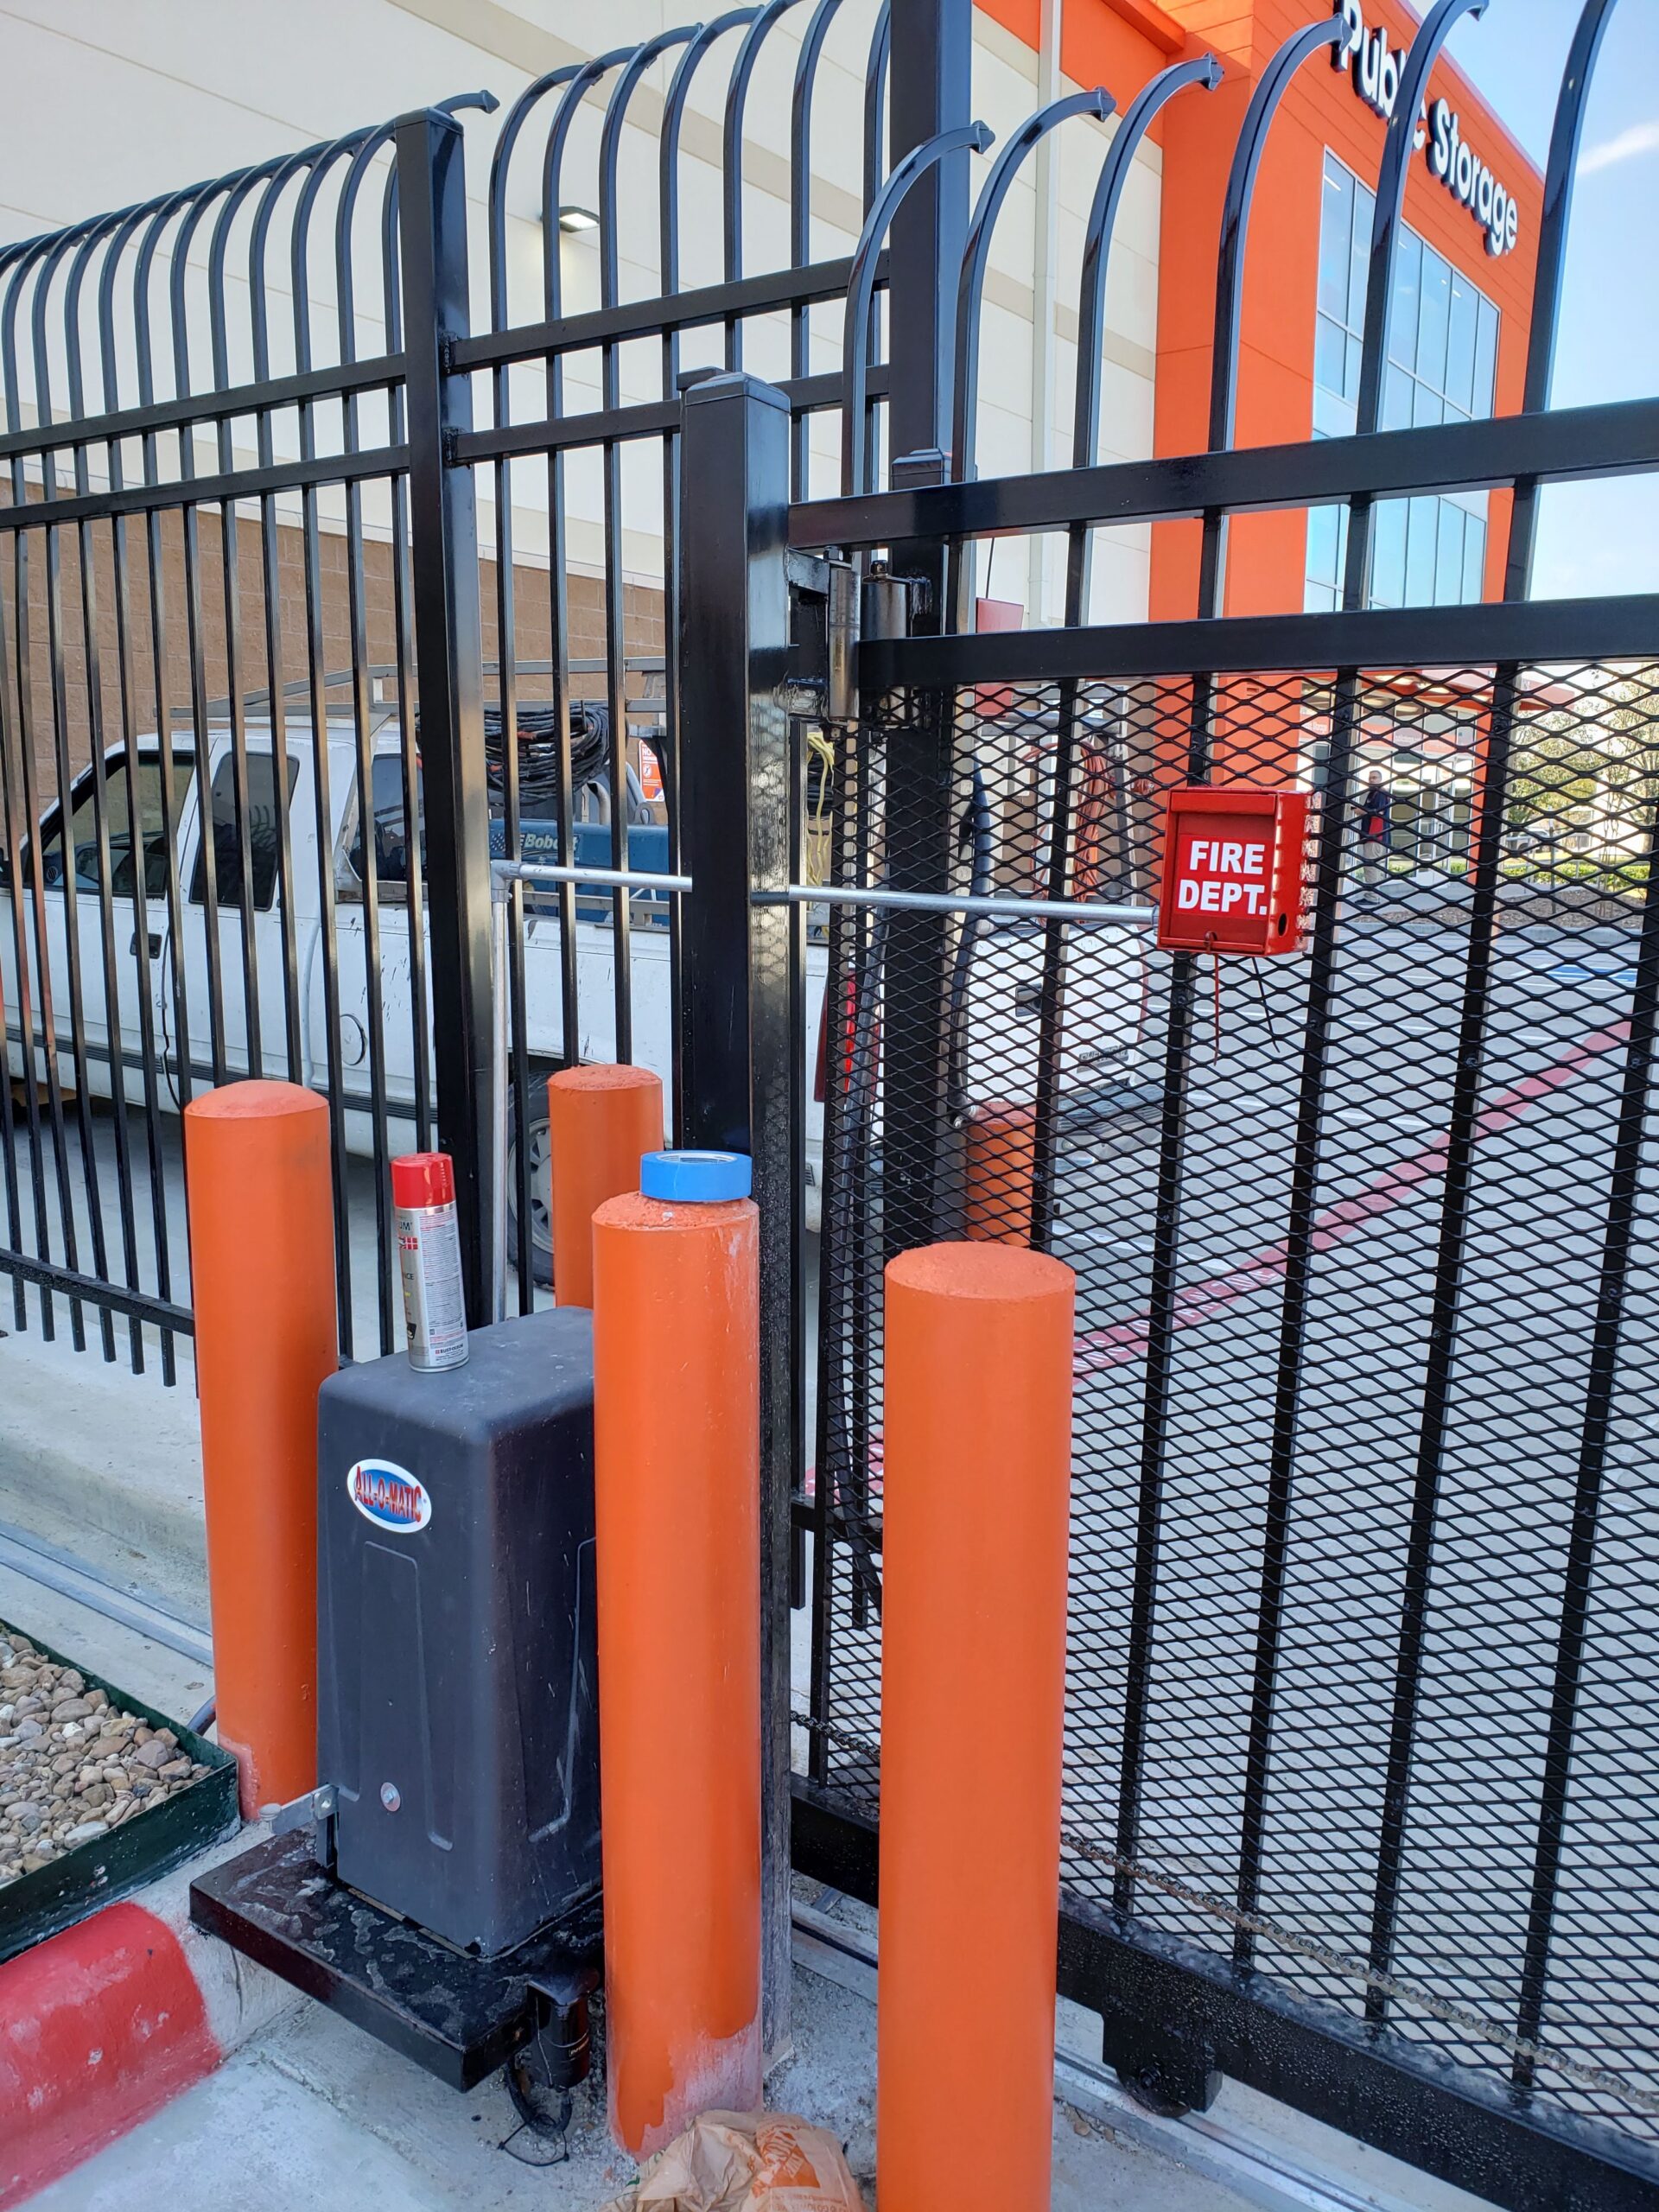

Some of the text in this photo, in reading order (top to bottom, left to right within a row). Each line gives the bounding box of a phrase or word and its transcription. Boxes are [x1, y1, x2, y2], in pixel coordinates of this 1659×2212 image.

[1434, 98, 1518, 257] Storage
[1189, 841, 1265, 875] FIRE
[1178, 880, 1268, 916] DEPT.
[354, 1465, 423, 1522] ALL-O-MATIC
